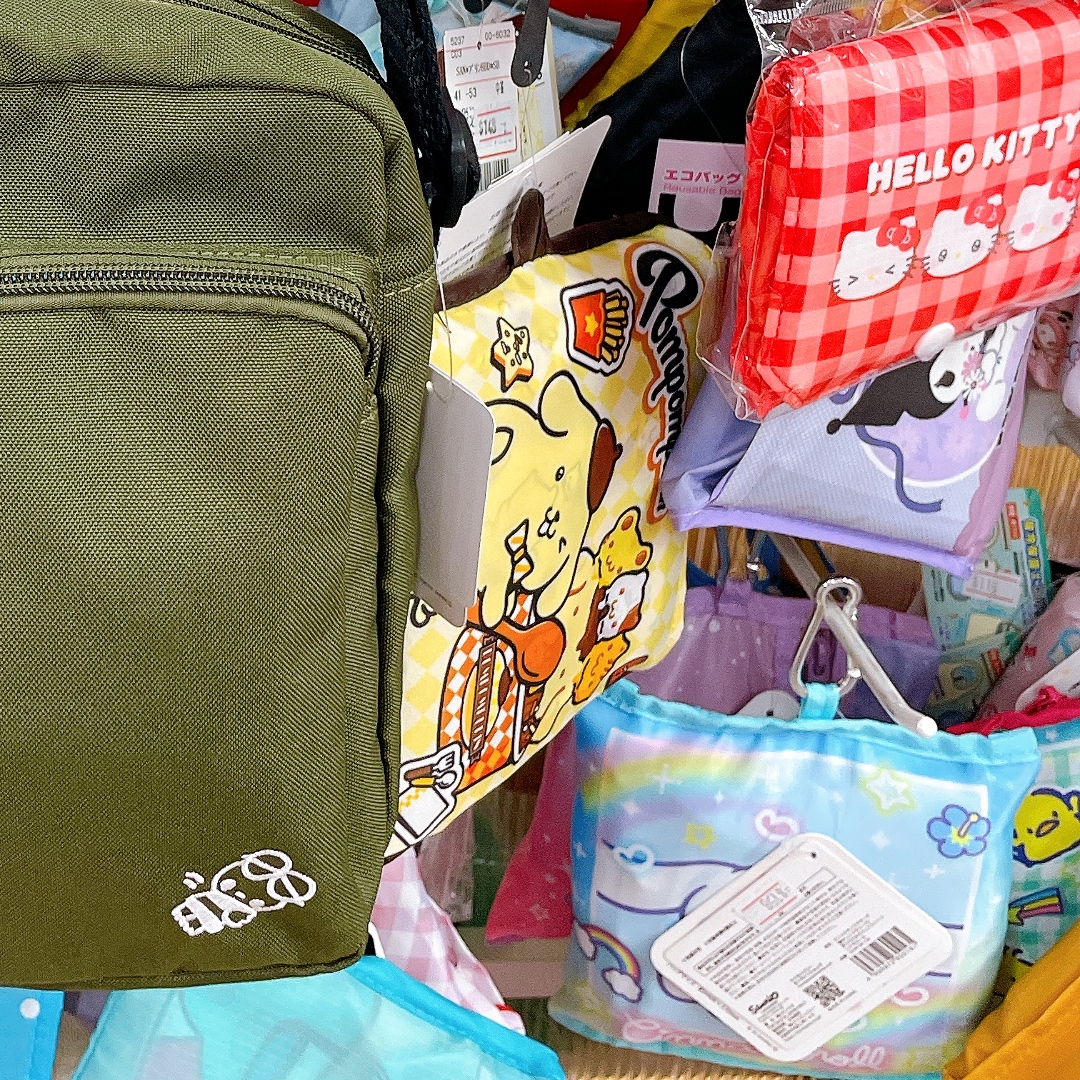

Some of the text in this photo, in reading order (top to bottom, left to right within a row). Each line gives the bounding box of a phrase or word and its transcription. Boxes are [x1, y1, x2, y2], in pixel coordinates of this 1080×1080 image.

[663, 168, 741, 184] エコバッグ
[866, 113, 1080, 195] HELLO KITTY
